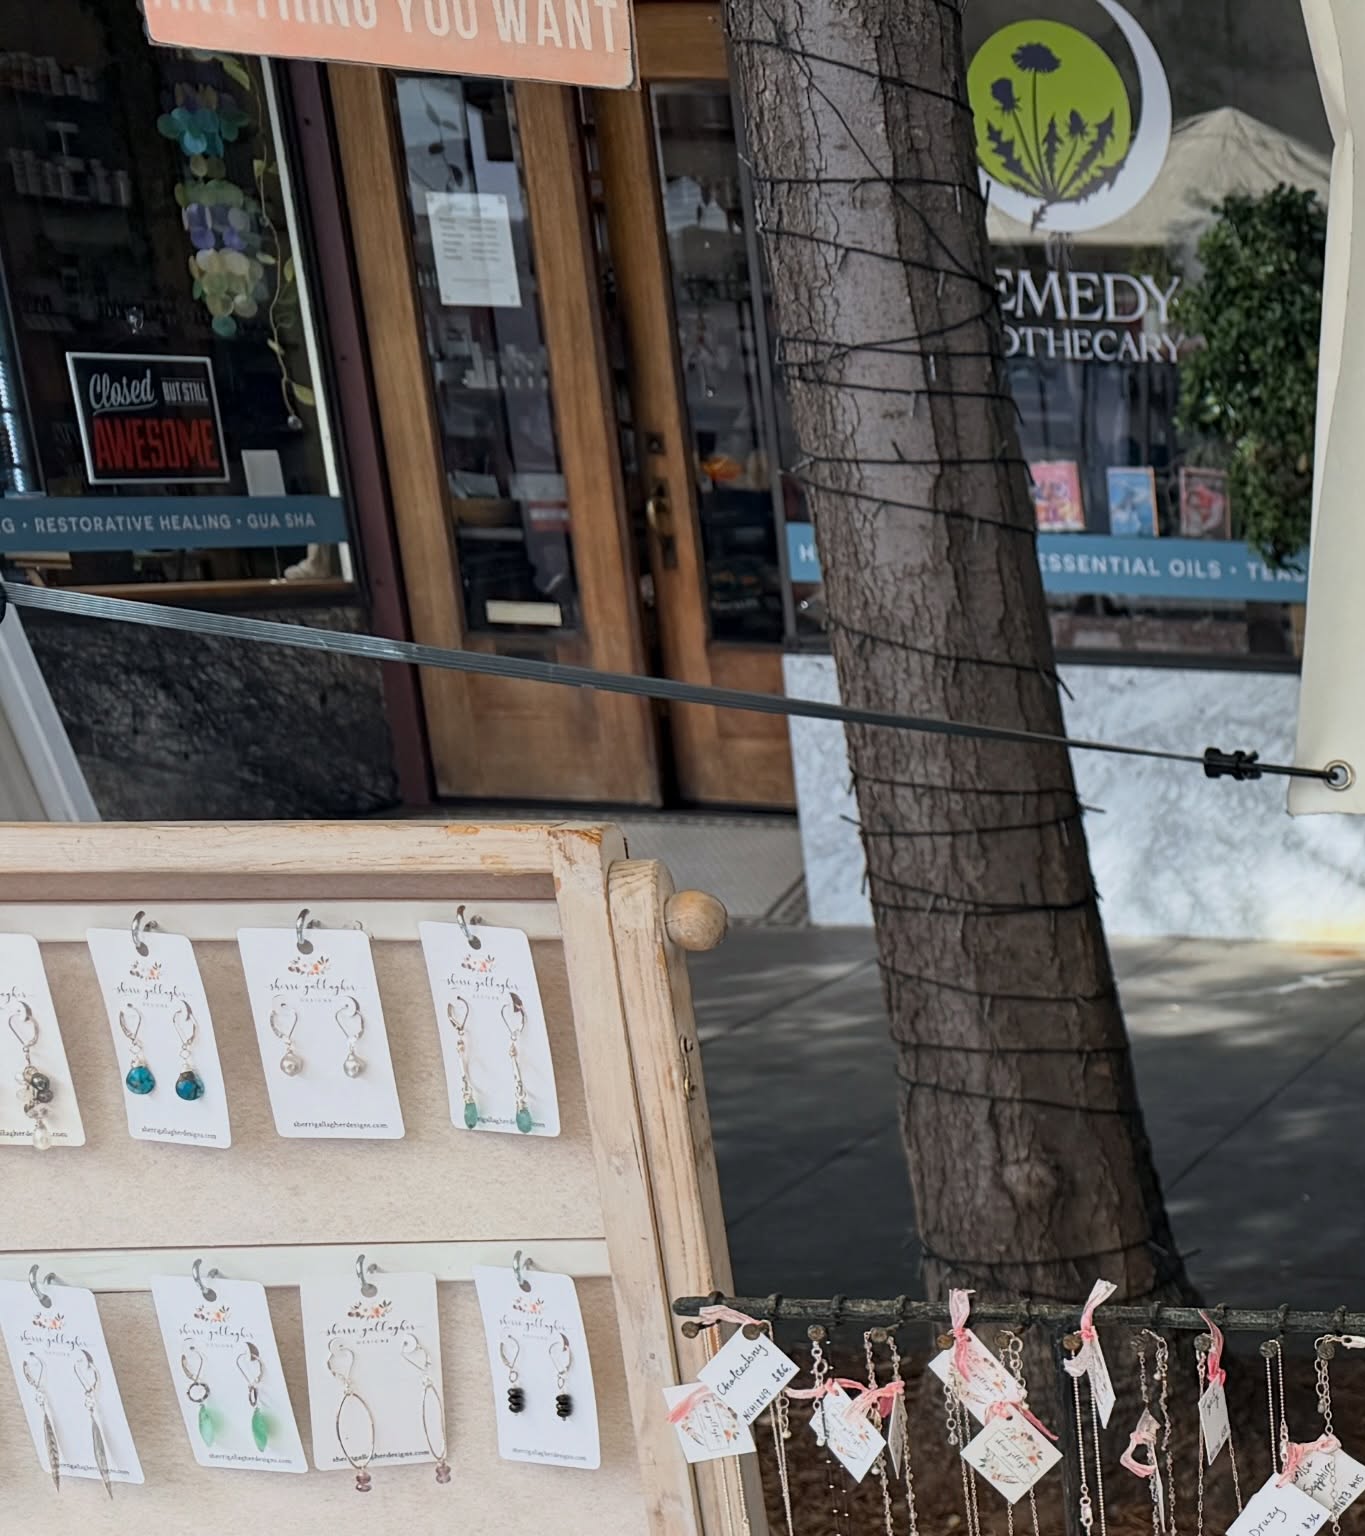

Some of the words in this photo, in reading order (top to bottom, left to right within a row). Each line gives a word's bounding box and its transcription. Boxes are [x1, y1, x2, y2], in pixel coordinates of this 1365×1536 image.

[493, 0, 617, 53] WANT
[994, 268, 1181, 323] EMEDY
[1003, 326, 1185, 364] OTHECARY
[89, 369, 157, 413] Closed
[93, 415, 219, 470] AWESOME
[35, 515, 154, 533] RESTORATIVE
[159, 513, 231, 531] HEALING
[247, 512, 281, 529] GUA
[284, 511, 316, 528] SHA
[1039, 552, 1161, 576] ESSENTIAL
[1168, 558, 1222, 580] OILS
